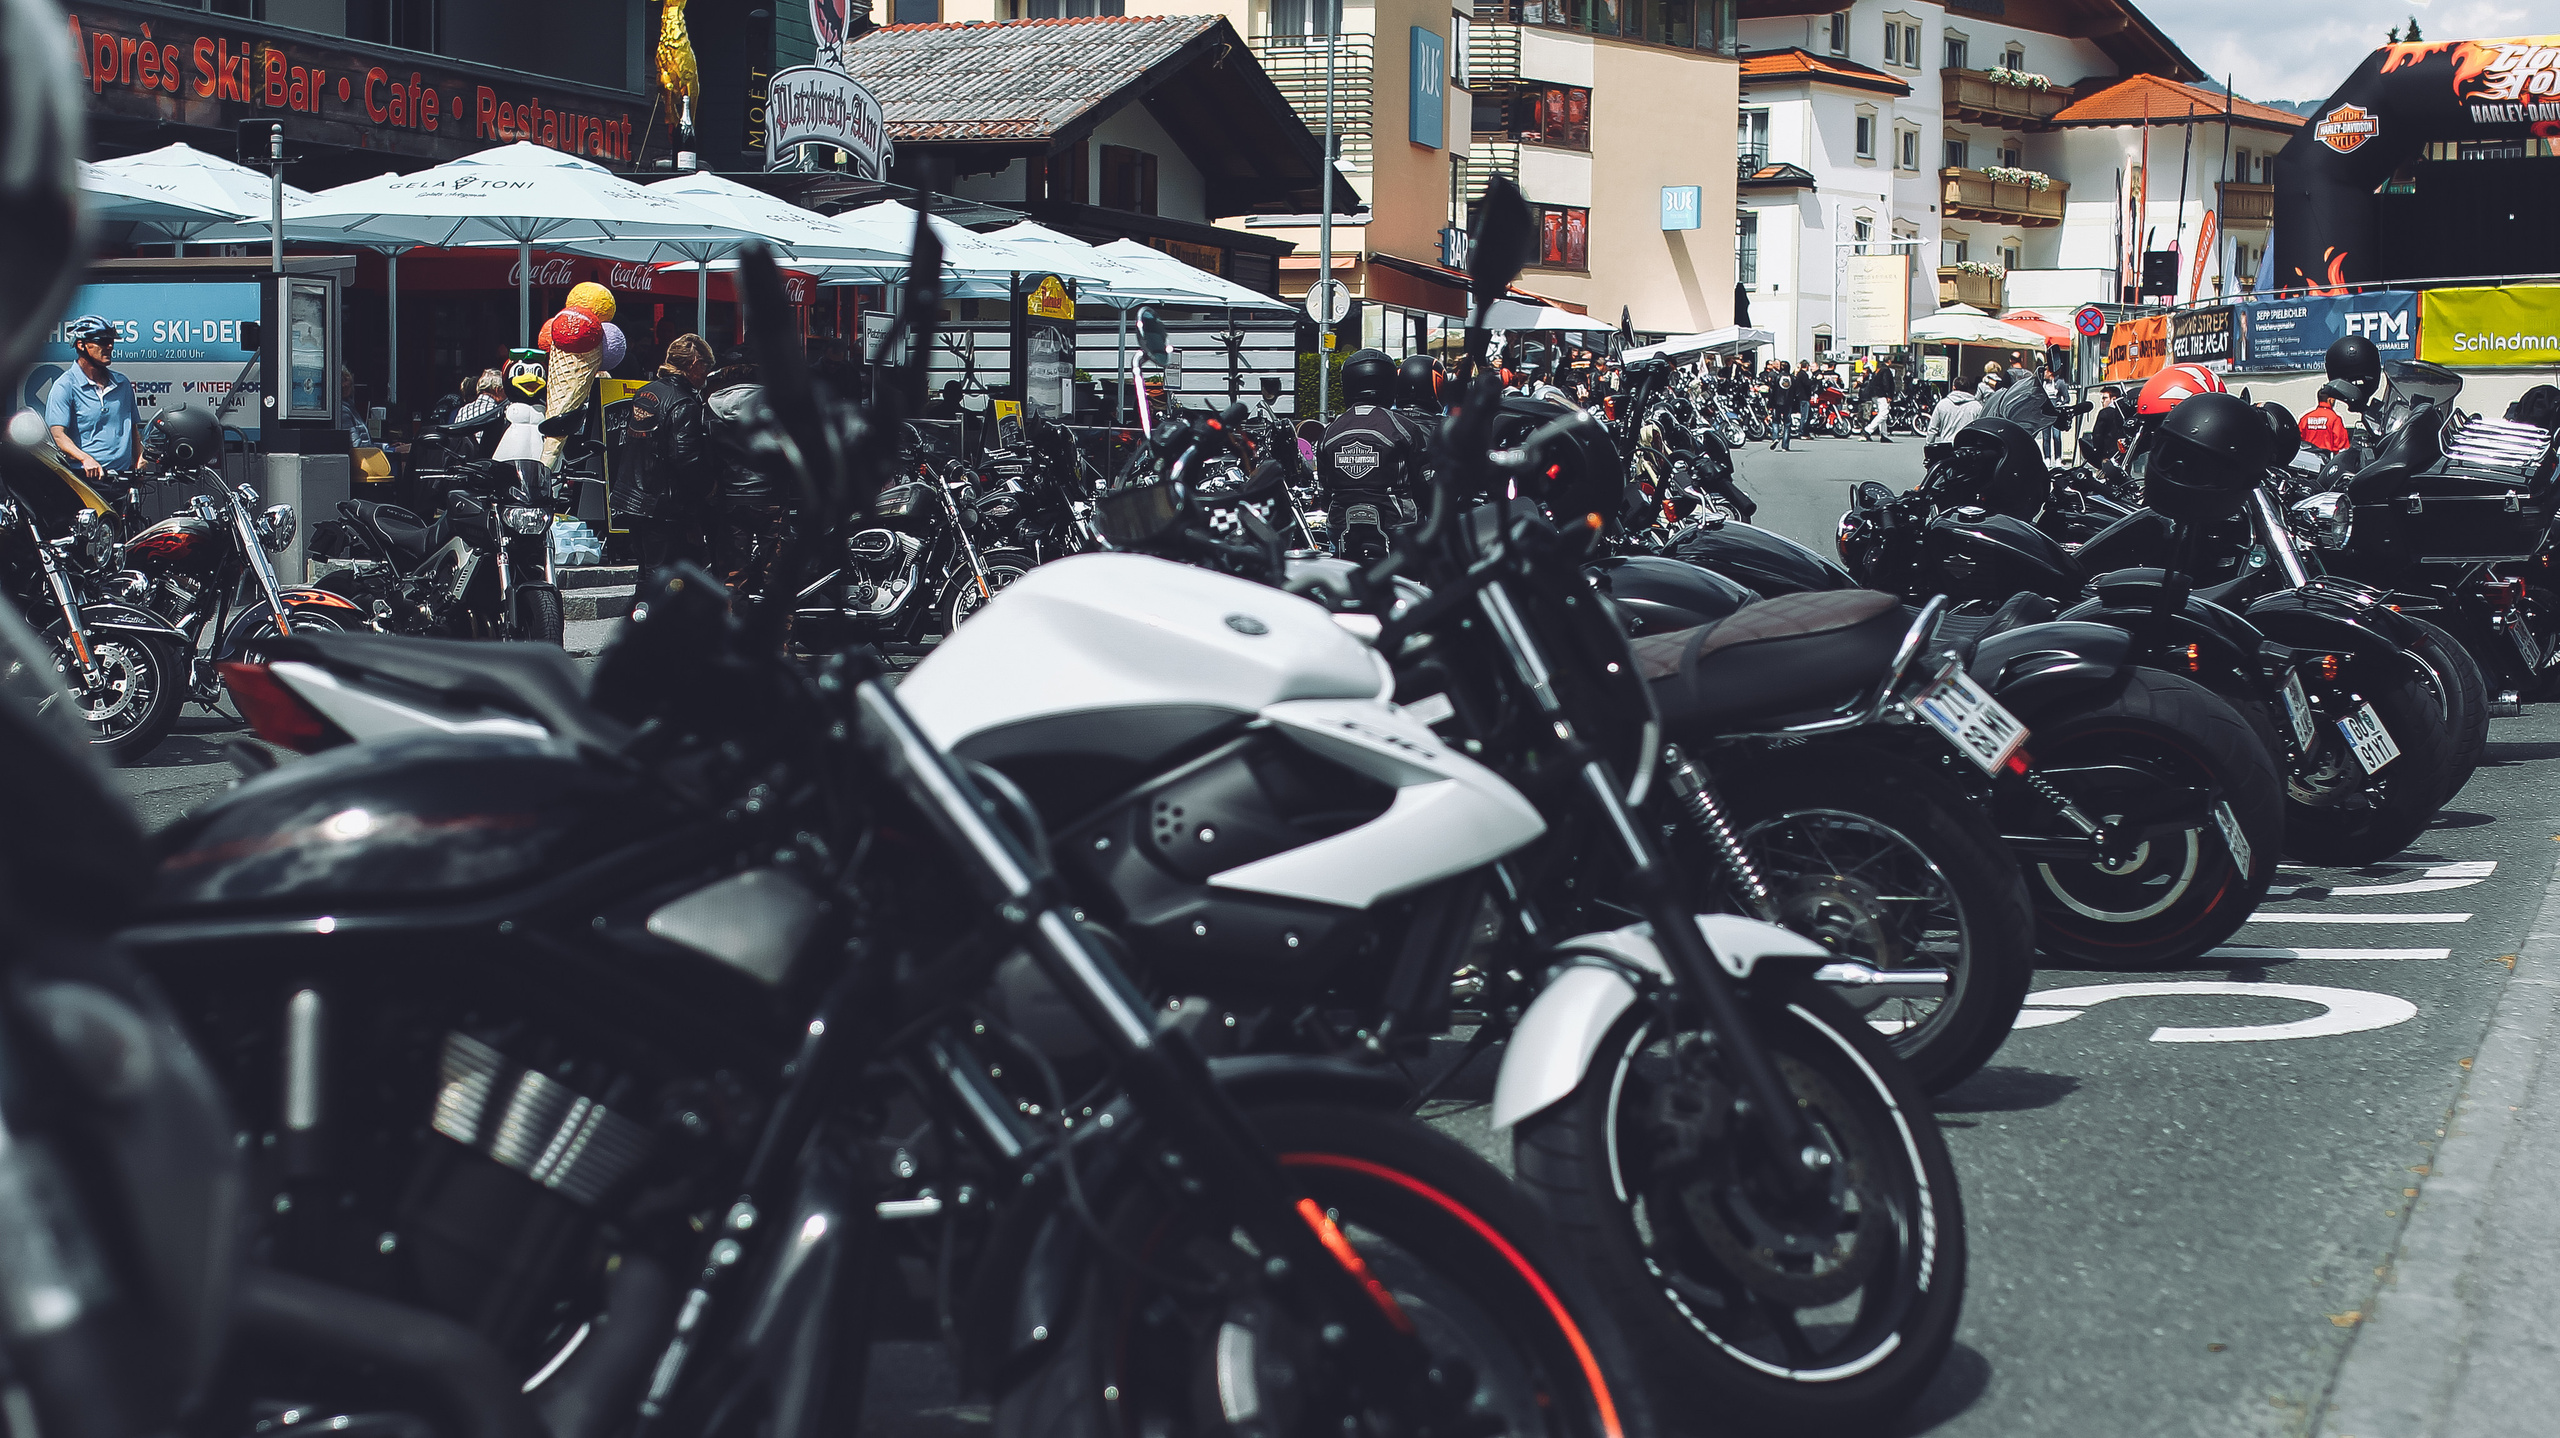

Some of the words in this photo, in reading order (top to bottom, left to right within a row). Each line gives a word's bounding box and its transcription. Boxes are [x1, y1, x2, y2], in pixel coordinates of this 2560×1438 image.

[193, 37, 250, 103] Ski
[265, 48, 326, 113] Bar
[364, 66, 440, 131] Cafe
[476, 85, 632, 162] Restaurant
[2319, 121, 2373, 135] HARLEY-DAVIDSON
[481, 180, 535, 189] TONI
[1449, 228, 1468, 271] BAR
[2344, 309, 2410, 341] FFM
[2190, 333, 2204, 356] THE
[2453, 332, 2560, 351] Schladmin
[141, 350, 157, 358] 7.00
[165, 350, 187, 358] 22.00
[189, 350, 205, 358] Uhr
[2348, 717, 2370, 741] GU
